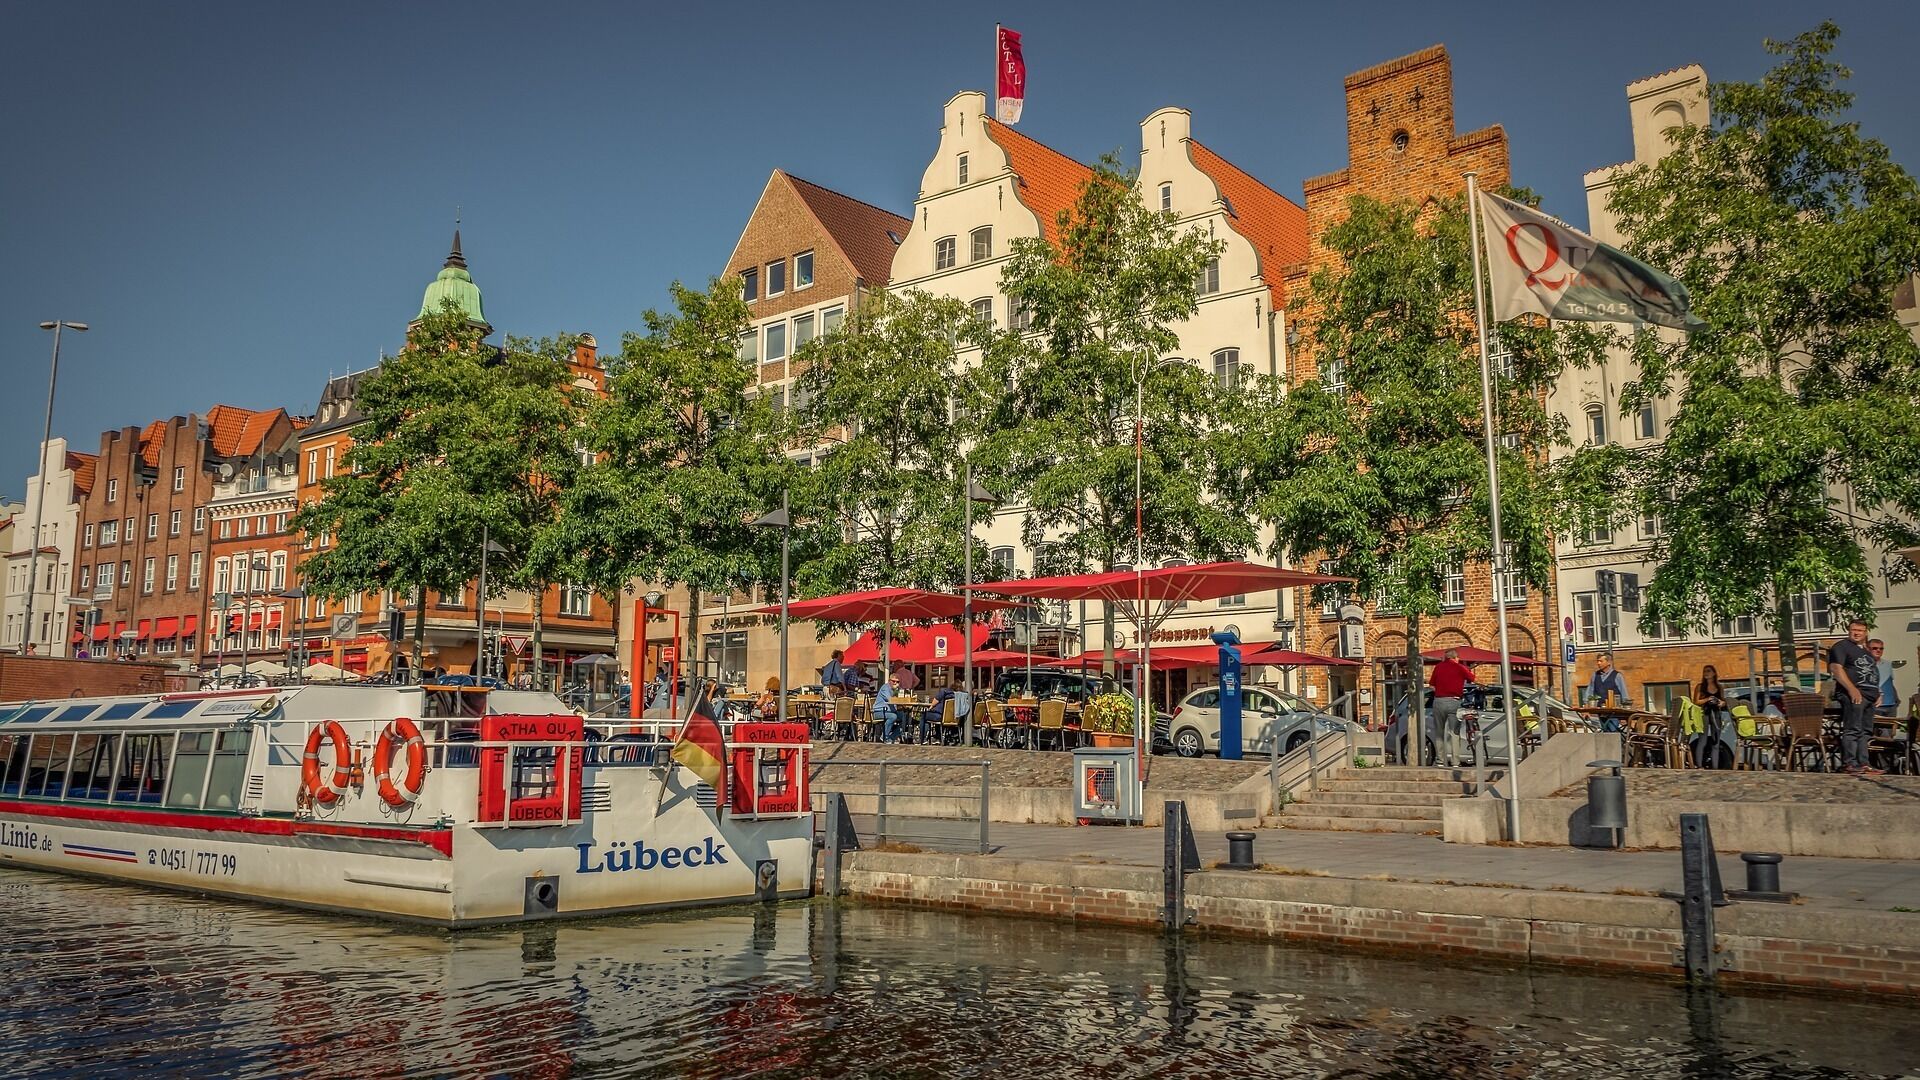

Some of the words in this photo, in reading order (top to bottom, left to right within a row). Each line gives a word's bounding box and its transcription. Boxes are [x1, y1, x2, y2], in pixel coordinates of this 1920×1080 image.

[1227, 656, 1235, 667] P
[161, 848, 186, 871] 0451
[196, 852, 218, 876] 777
[222, 854, 237, 876] 99
[576, 836, 729, 873] Lübeck
